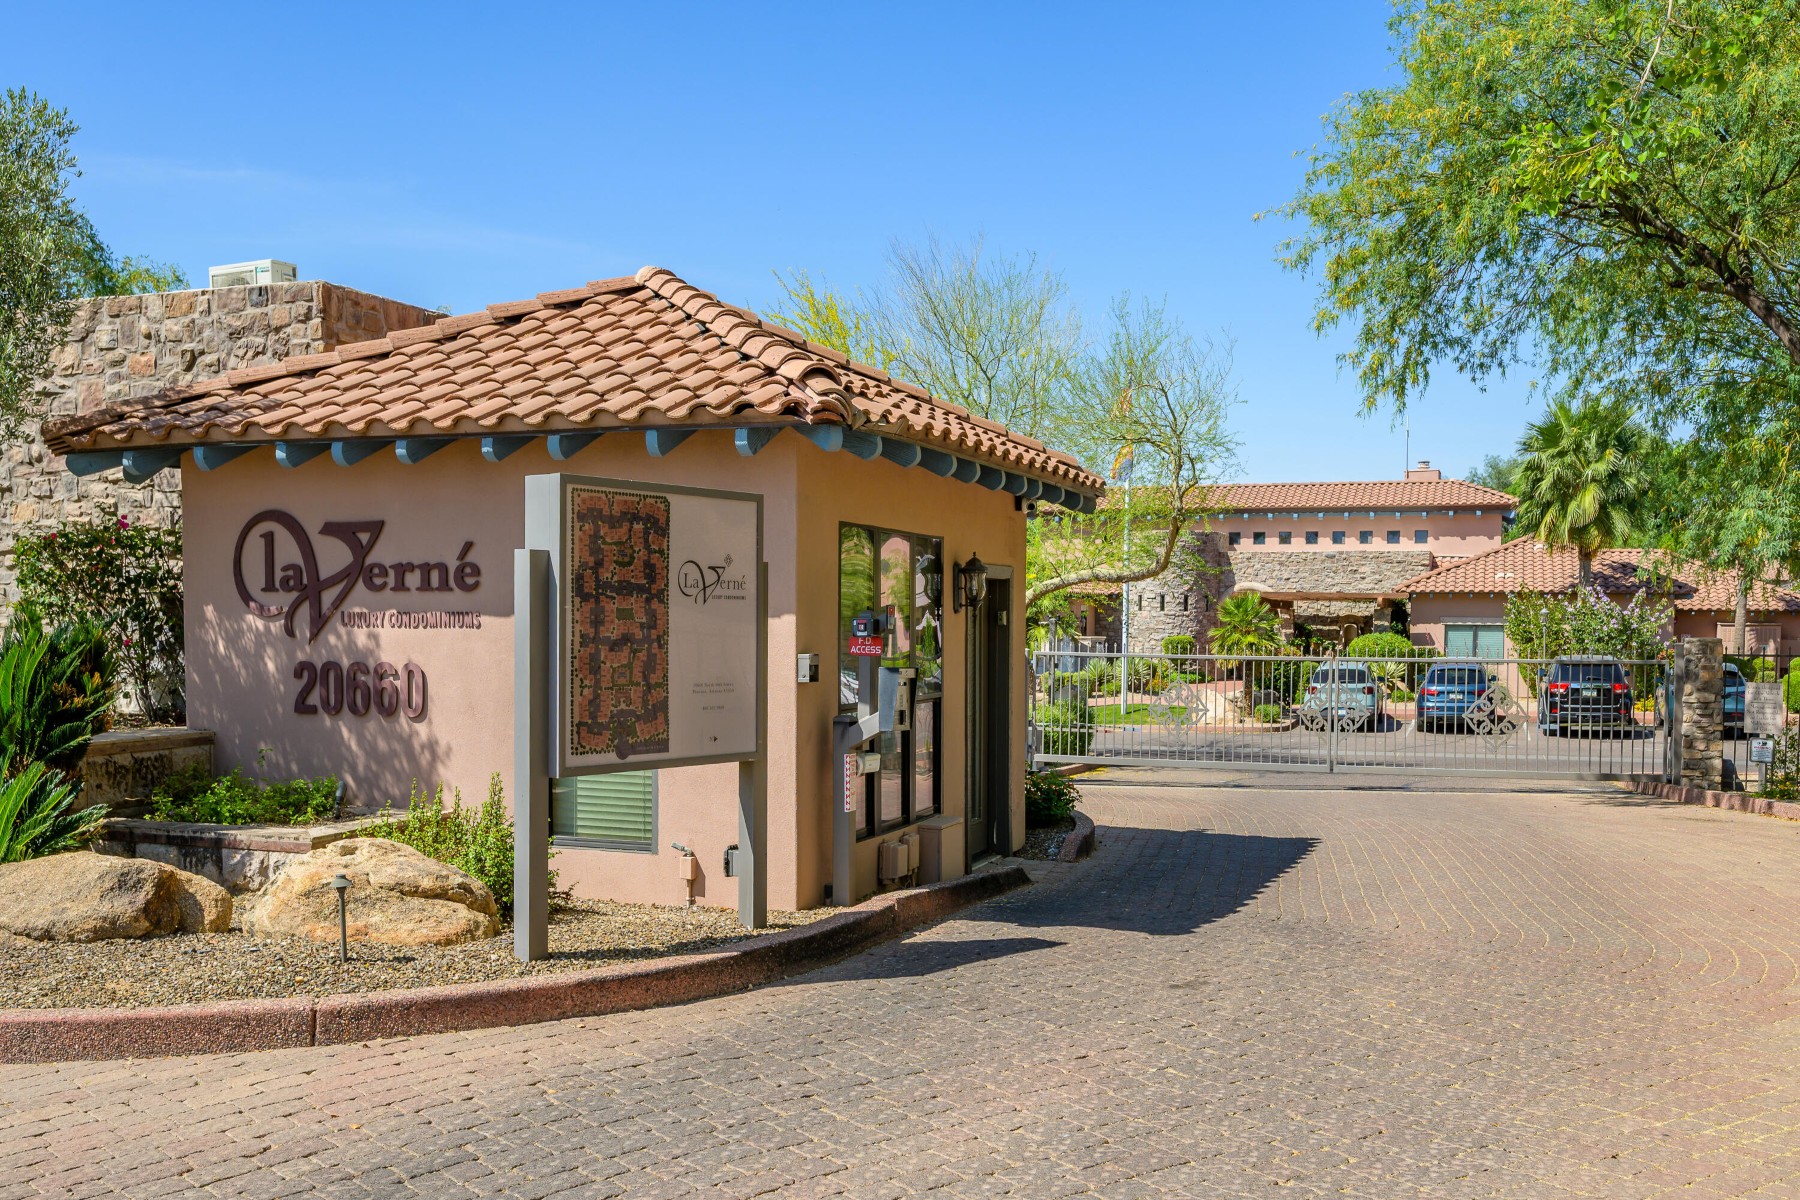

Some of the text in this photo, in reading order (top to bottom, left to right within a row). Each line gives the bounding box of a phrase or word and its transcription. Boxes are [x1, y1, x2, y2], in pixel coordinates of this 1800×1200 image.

[341, 611, 385, 629] LUXURY
[850, 645, 882, 654] ACCESS
[294, 660, 425, 718] 20660
